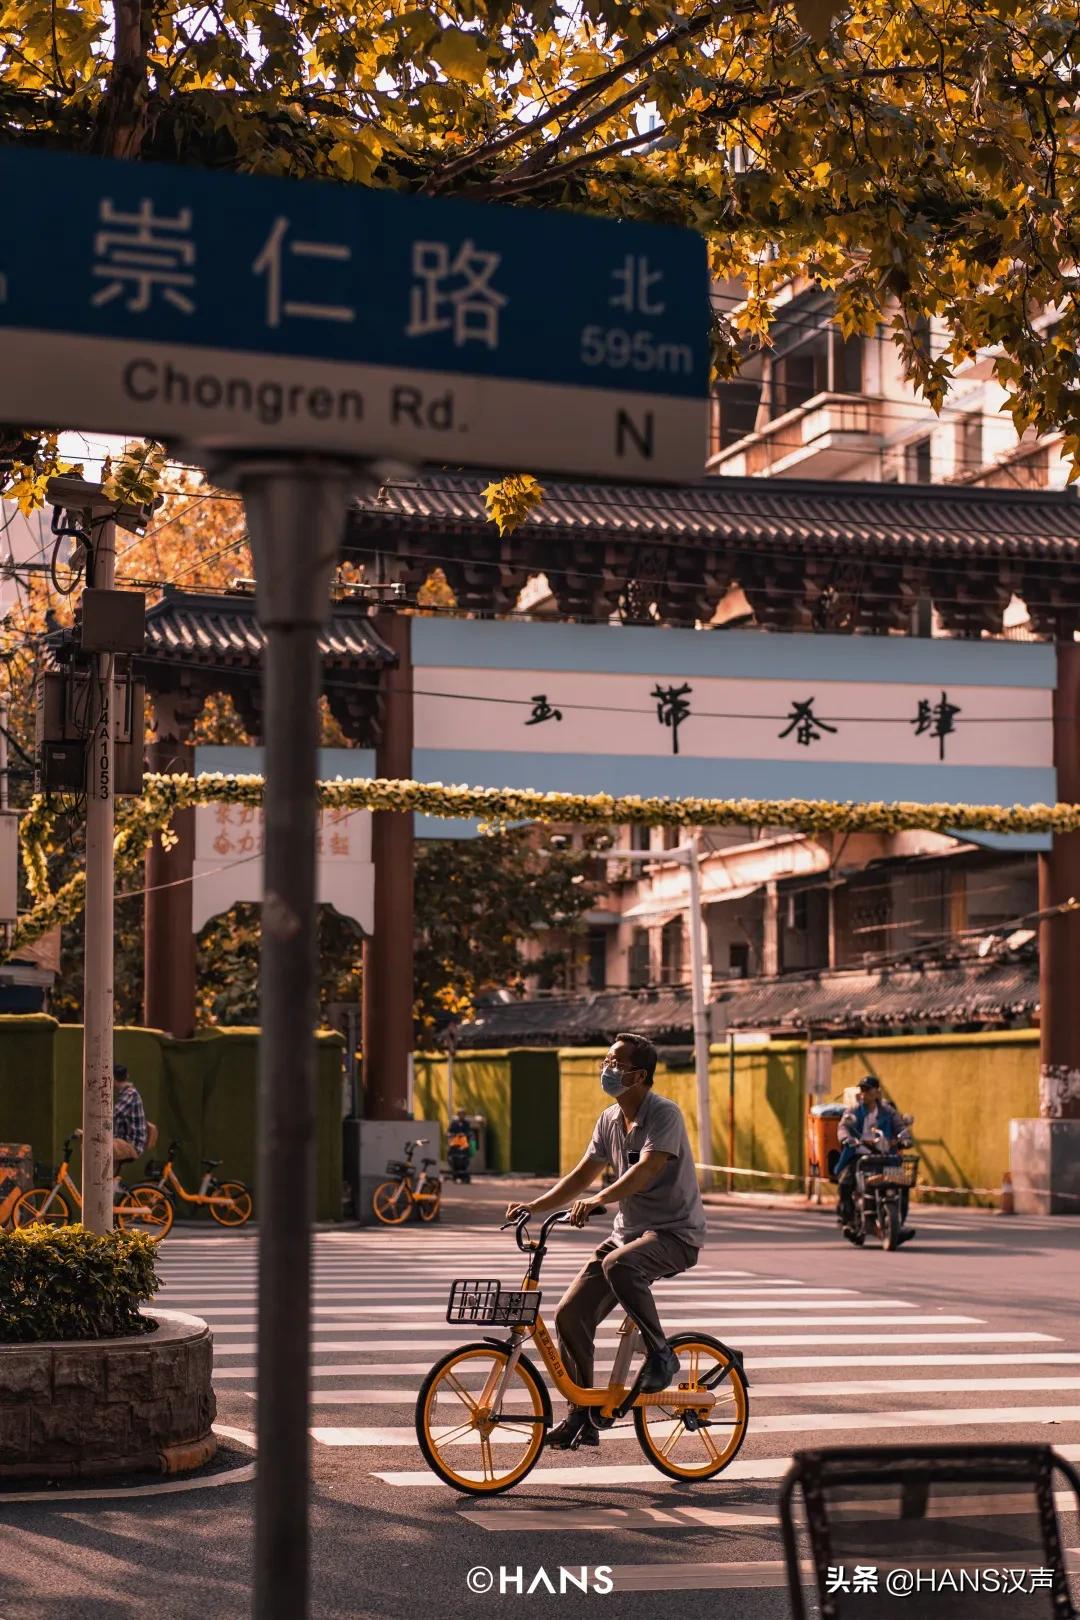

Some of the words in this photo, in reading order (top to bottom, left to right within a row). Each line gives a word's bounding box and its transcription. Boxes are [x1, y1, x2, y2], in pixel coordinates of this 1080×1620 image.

[91, 198, 507, 349] 崇仁路
[610, 254, 665, 316] 北
[580, 327, 693, 373] 595m
[122, 358, 365, 424] Chongren
[391, 385, 469, 433] Rd.
[615, 409, 655, 459] N
